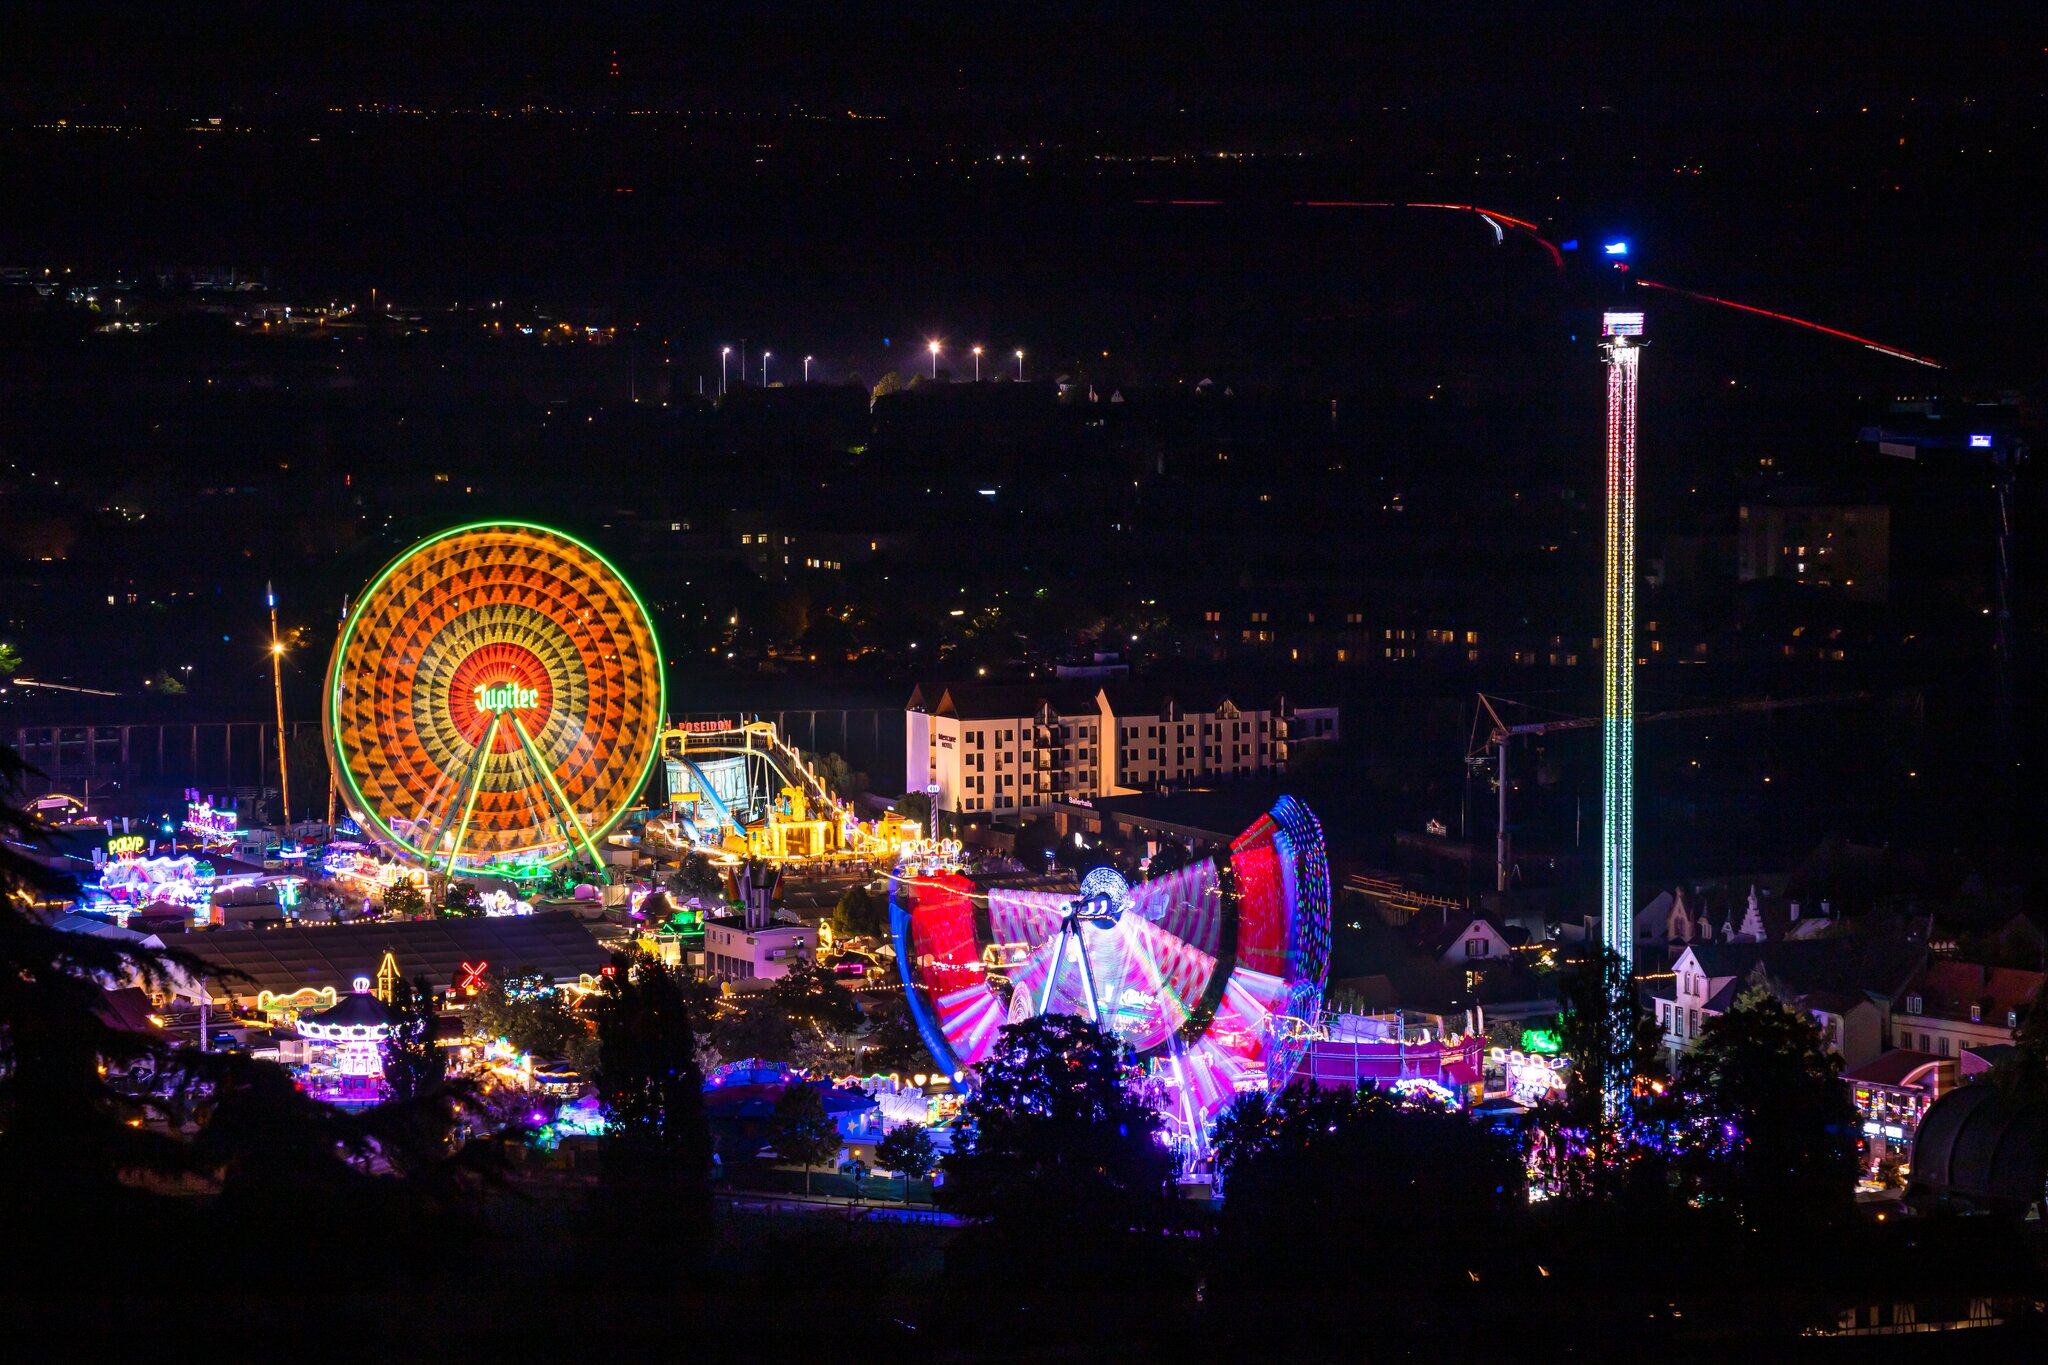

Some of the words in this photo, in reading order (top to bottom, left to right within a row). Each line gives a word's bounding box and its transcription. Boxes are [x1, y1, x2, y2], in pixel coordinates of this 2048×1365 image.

[473, 682, 539, 715] Jupiter
[678, 720, 732, 733] POSEIDON
[108, 836, 144, 855] POLYP
[117, 851, 136, 862] XXL
